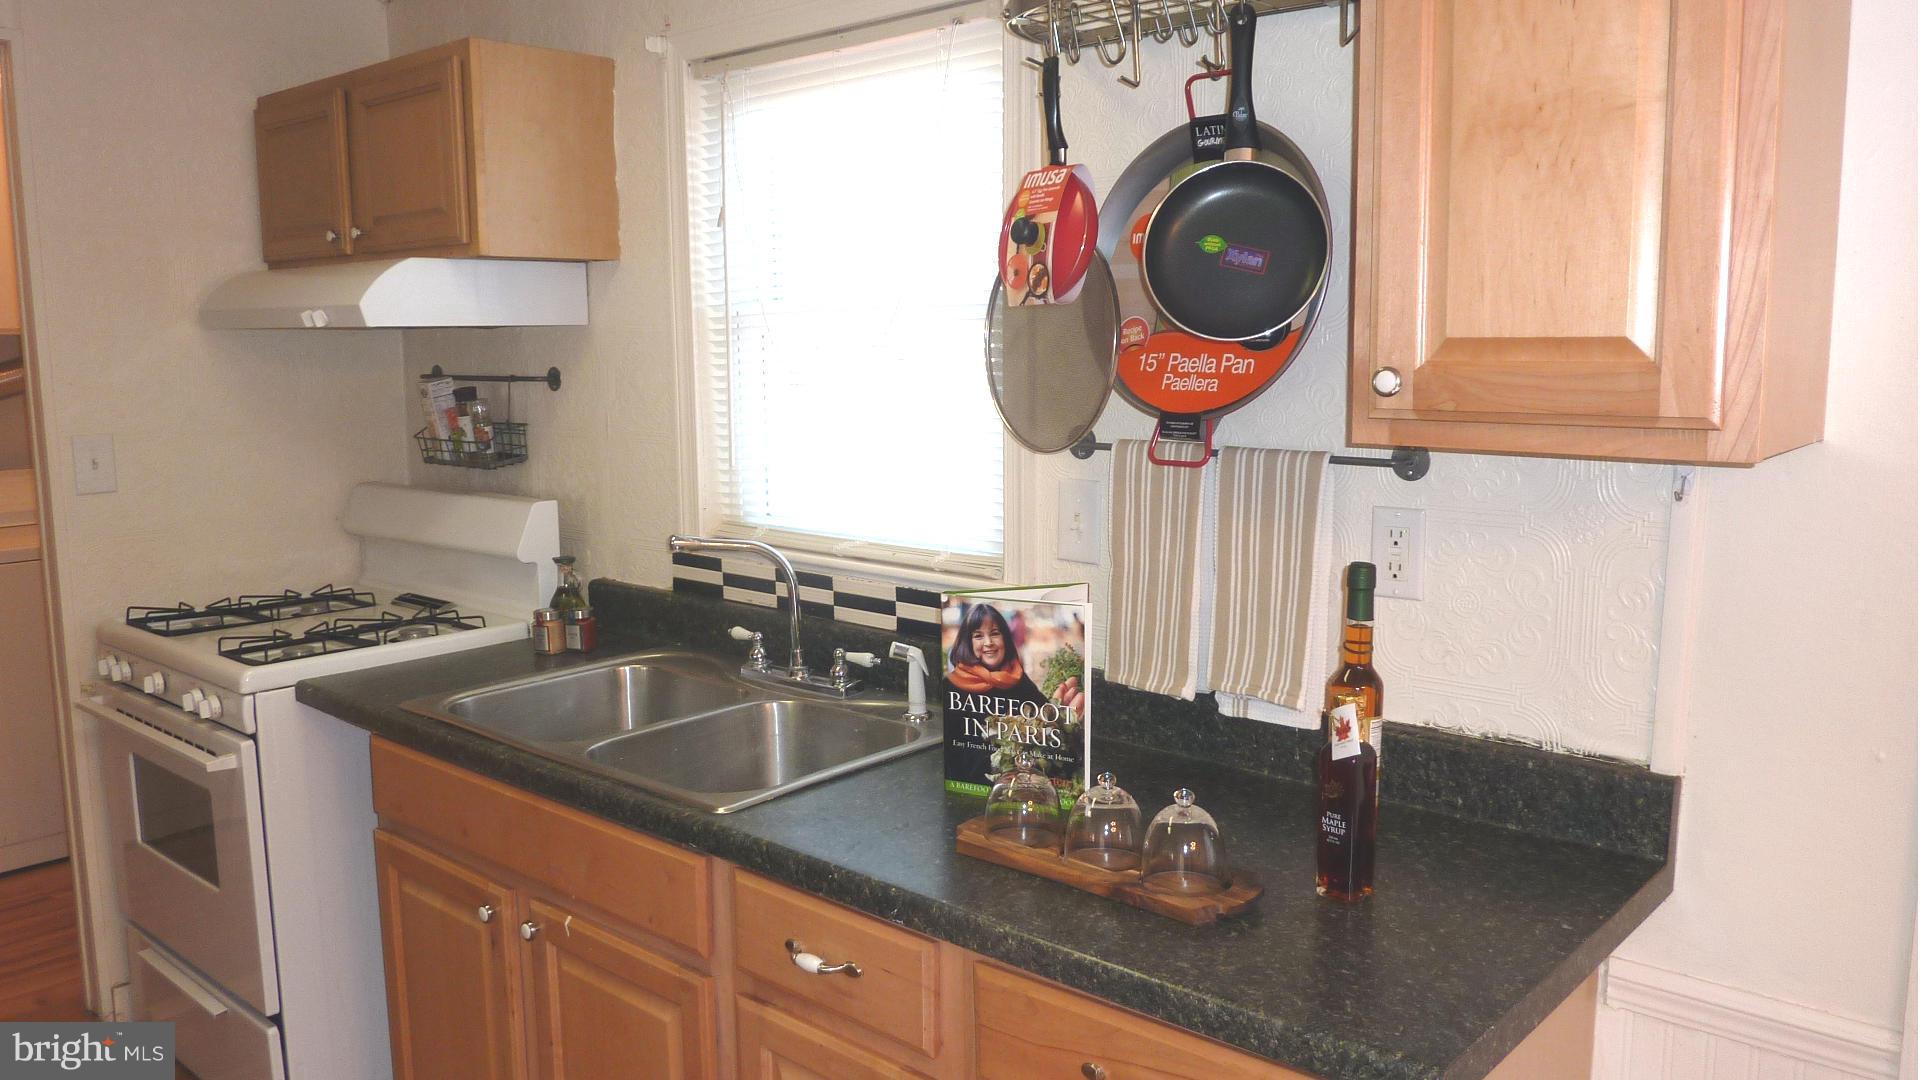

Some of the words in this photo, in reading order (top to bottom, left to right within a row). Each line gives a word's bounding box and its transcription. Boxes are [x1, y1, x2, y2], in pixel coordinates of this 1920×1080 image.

[1130, 332, 1145, 343] Back
[1167, 353, 1216, 374] Paella
[1220, 354, 1255, 374] Pan
[1161, 373, 1218, 392] Paellera
[948, 691, 1077, 725] BAREFOOT
[963, 717, 990, 738] IN
[996, 721, 1061, 748] PARIS
[952, 739, 966, 749] Easy
[967, 741, 987, 751] French
[1055, 753, 1075, 763] Home
[1321, 816, 1347, 829] MAPLE
[1326, 811, 1341, 820] PURE
[1322, 823, 1346, 836] SYRUP
